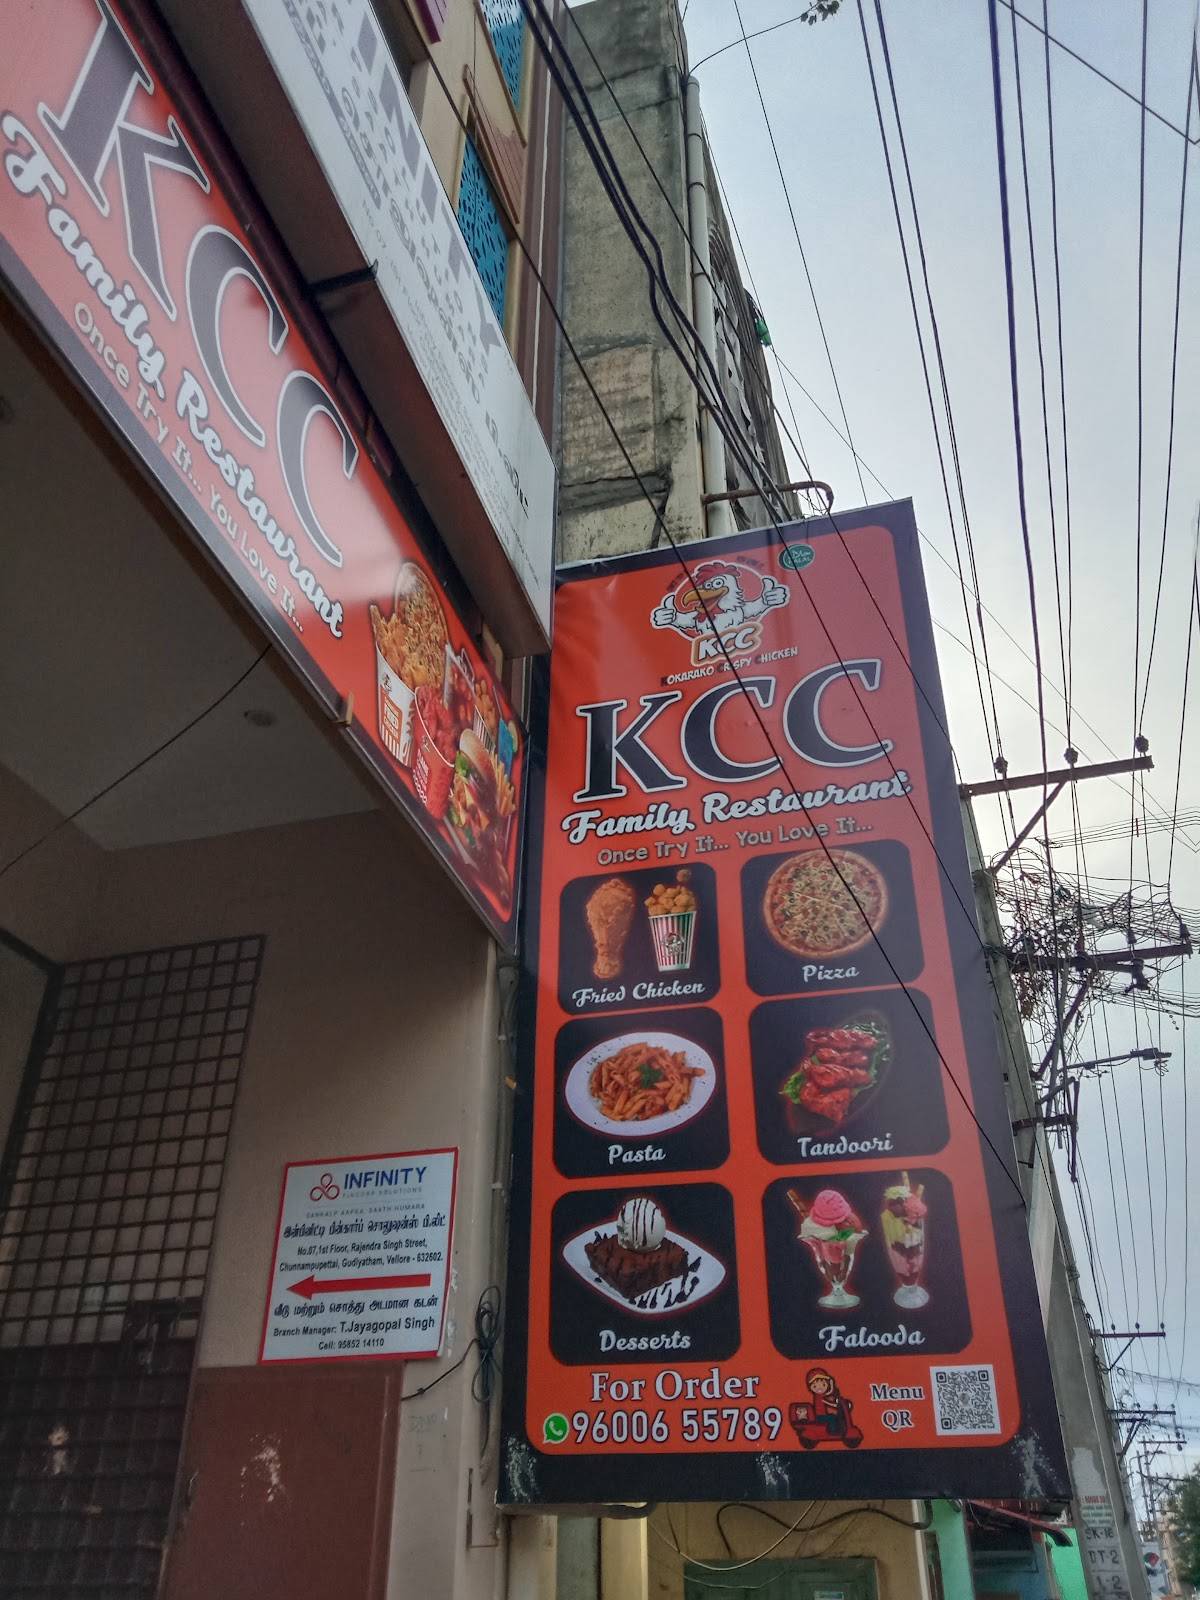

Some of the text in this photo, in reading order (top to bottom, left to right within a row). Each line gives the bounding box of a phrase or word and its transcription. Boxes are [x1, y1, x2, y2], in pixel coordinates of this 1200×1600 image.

[38, 0, 359, 566] KCC
[1, 112, 166, 400] Family
[176, 370, 343, 639] Restaurant
[74, 302, 131, 388] Once
[135, 387, 169, 443] Try
[208, 489, 239, 541] You
[239, 533, 279, 599] Love
[698, 626, 754, 661] KCC
[716, 656, 752, 674] CRSPY
[573, 659, 893, 803] KCC
[561, 769, 913, 845] Family Restaurant
[597, 846, 648, 866] Once
[655, 839, 688, 859] Try
[736, 828, 773, 848] You
[778, 821, 828, 842] Love
[802, 963, 860, 984] Pizza
[572, 979, 706, 1008] Fried Chicken
[607, 1143, 667, 1166] Pasta
[797, 1132, 895, 1159] Tandoori
[344, 1166, 427, 1190] INFINITY
[330, 1243, 349, 1255] Floor,
[351, 1240, 382, 1253] Rajendra
[383, 1239, 403, 1252] Singh
[404, 1237, 428, 1250] Street,
[387, 1253, 411, 1265] Vellore
[273, 1326, 300, 1337] Branch
[302, 1324, 338, 1336] Manager:
[404, 1315, 436, 1330] Singh
[819, 1324, 927, 1353] Falooda
[599, 1329, 692, 1354] Desserts
[591, 1366, 760, 1402] For Order
[869, 1381, 924, 1402] Menu
[572, 1406, 783, 1444] 96006 55789
[881, 1409, 914, 1432] QR
